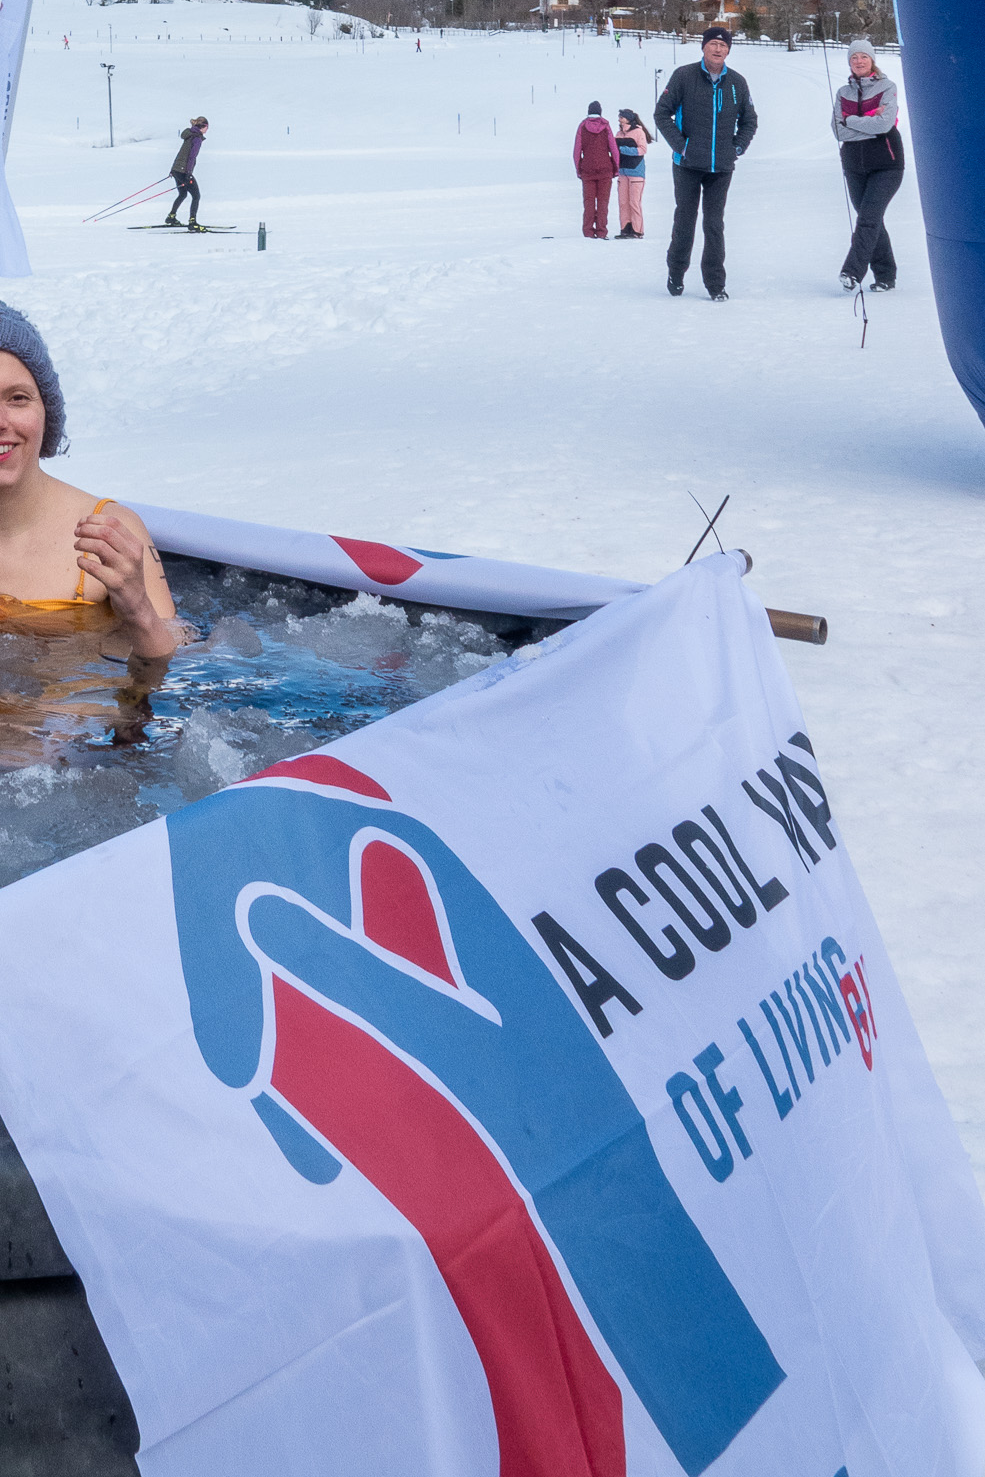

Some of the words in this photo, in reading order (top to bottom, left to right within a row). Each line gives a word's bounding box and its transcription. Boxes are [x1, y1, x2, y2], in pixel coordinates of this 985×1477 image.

[531, 911, 643, 1039] A
[594, 804, 790, 981] COOL
[665, 1041, 754, 1183] OF
